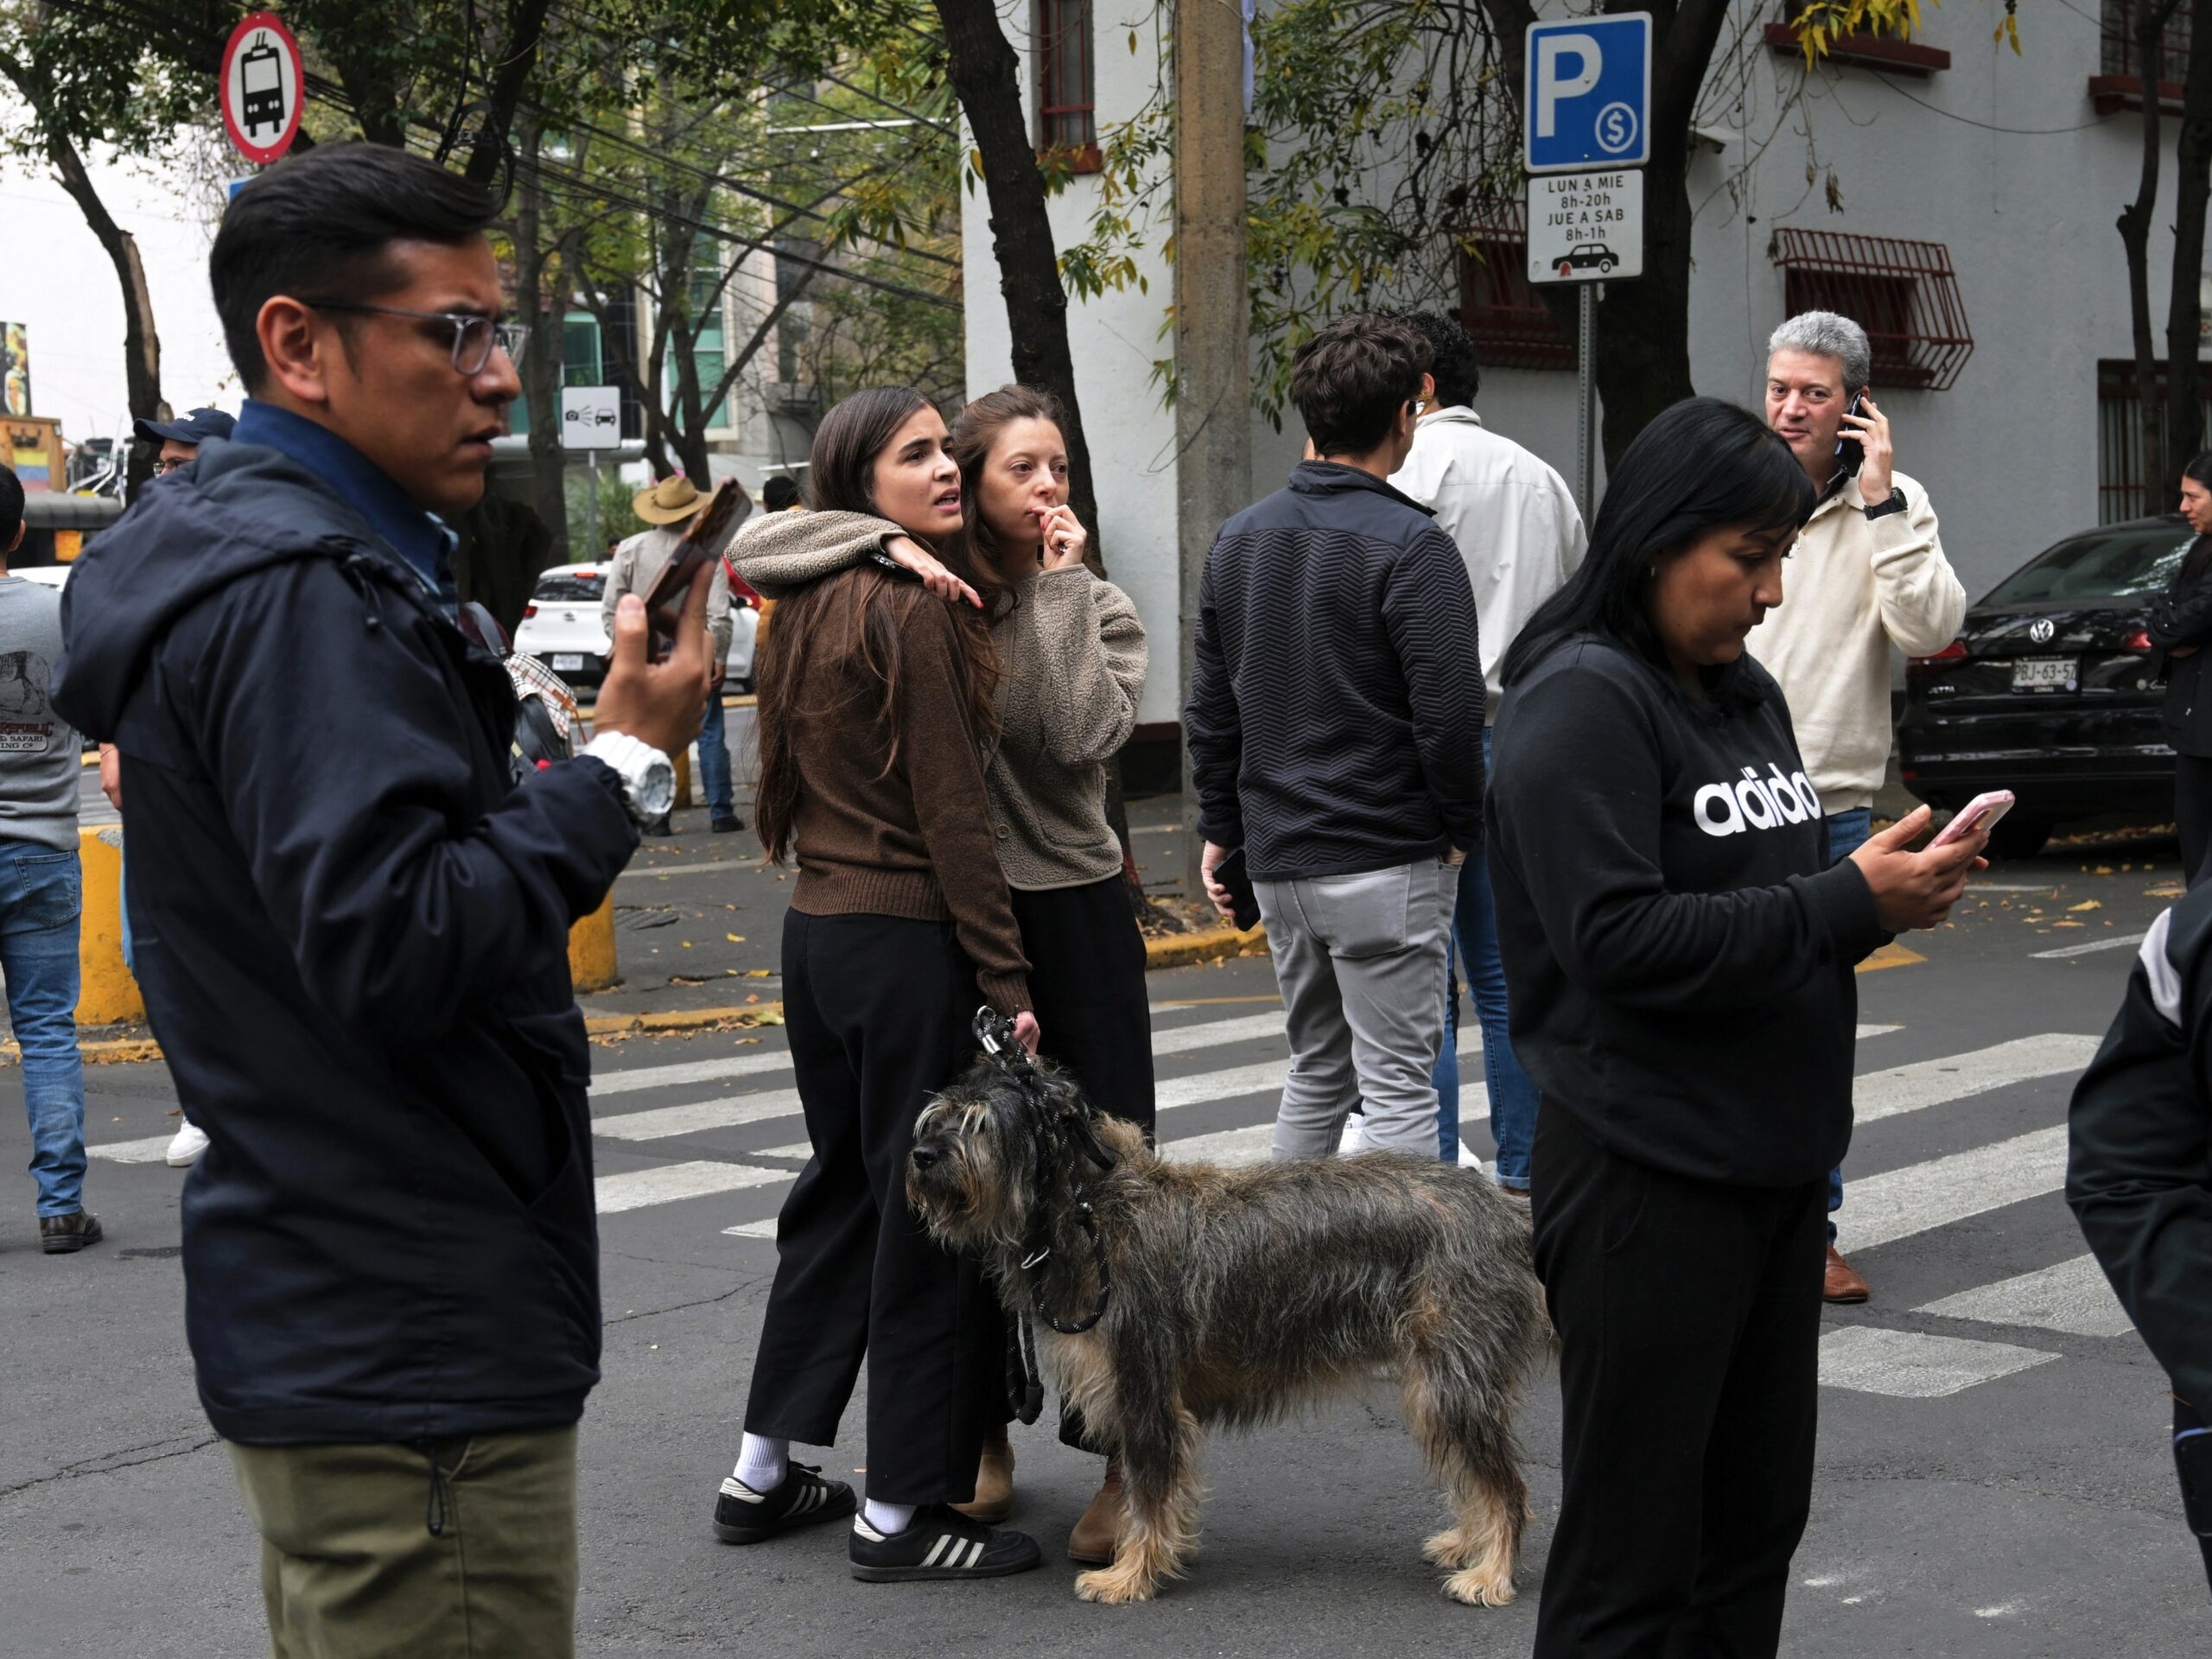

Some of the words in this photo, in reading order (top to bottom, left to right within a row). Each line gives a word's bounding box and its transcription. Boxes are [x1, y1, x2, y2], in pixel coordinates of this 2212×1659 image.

[1536, 34, 1603, 138] P
[1548, 179, 1578, 194] LUN
[1583, 177, 1592, 192] A
[1598, 175, 1624, 189] MIE
[1560, 192, 1611, 209] 8h-20h
[1548, 212, 1574, 226] JUE
[1579, 210, 1589, 224] A
[1594, 208, 1624, 223] SAB
[1566, 226, 1606, 241] 8h-1h
